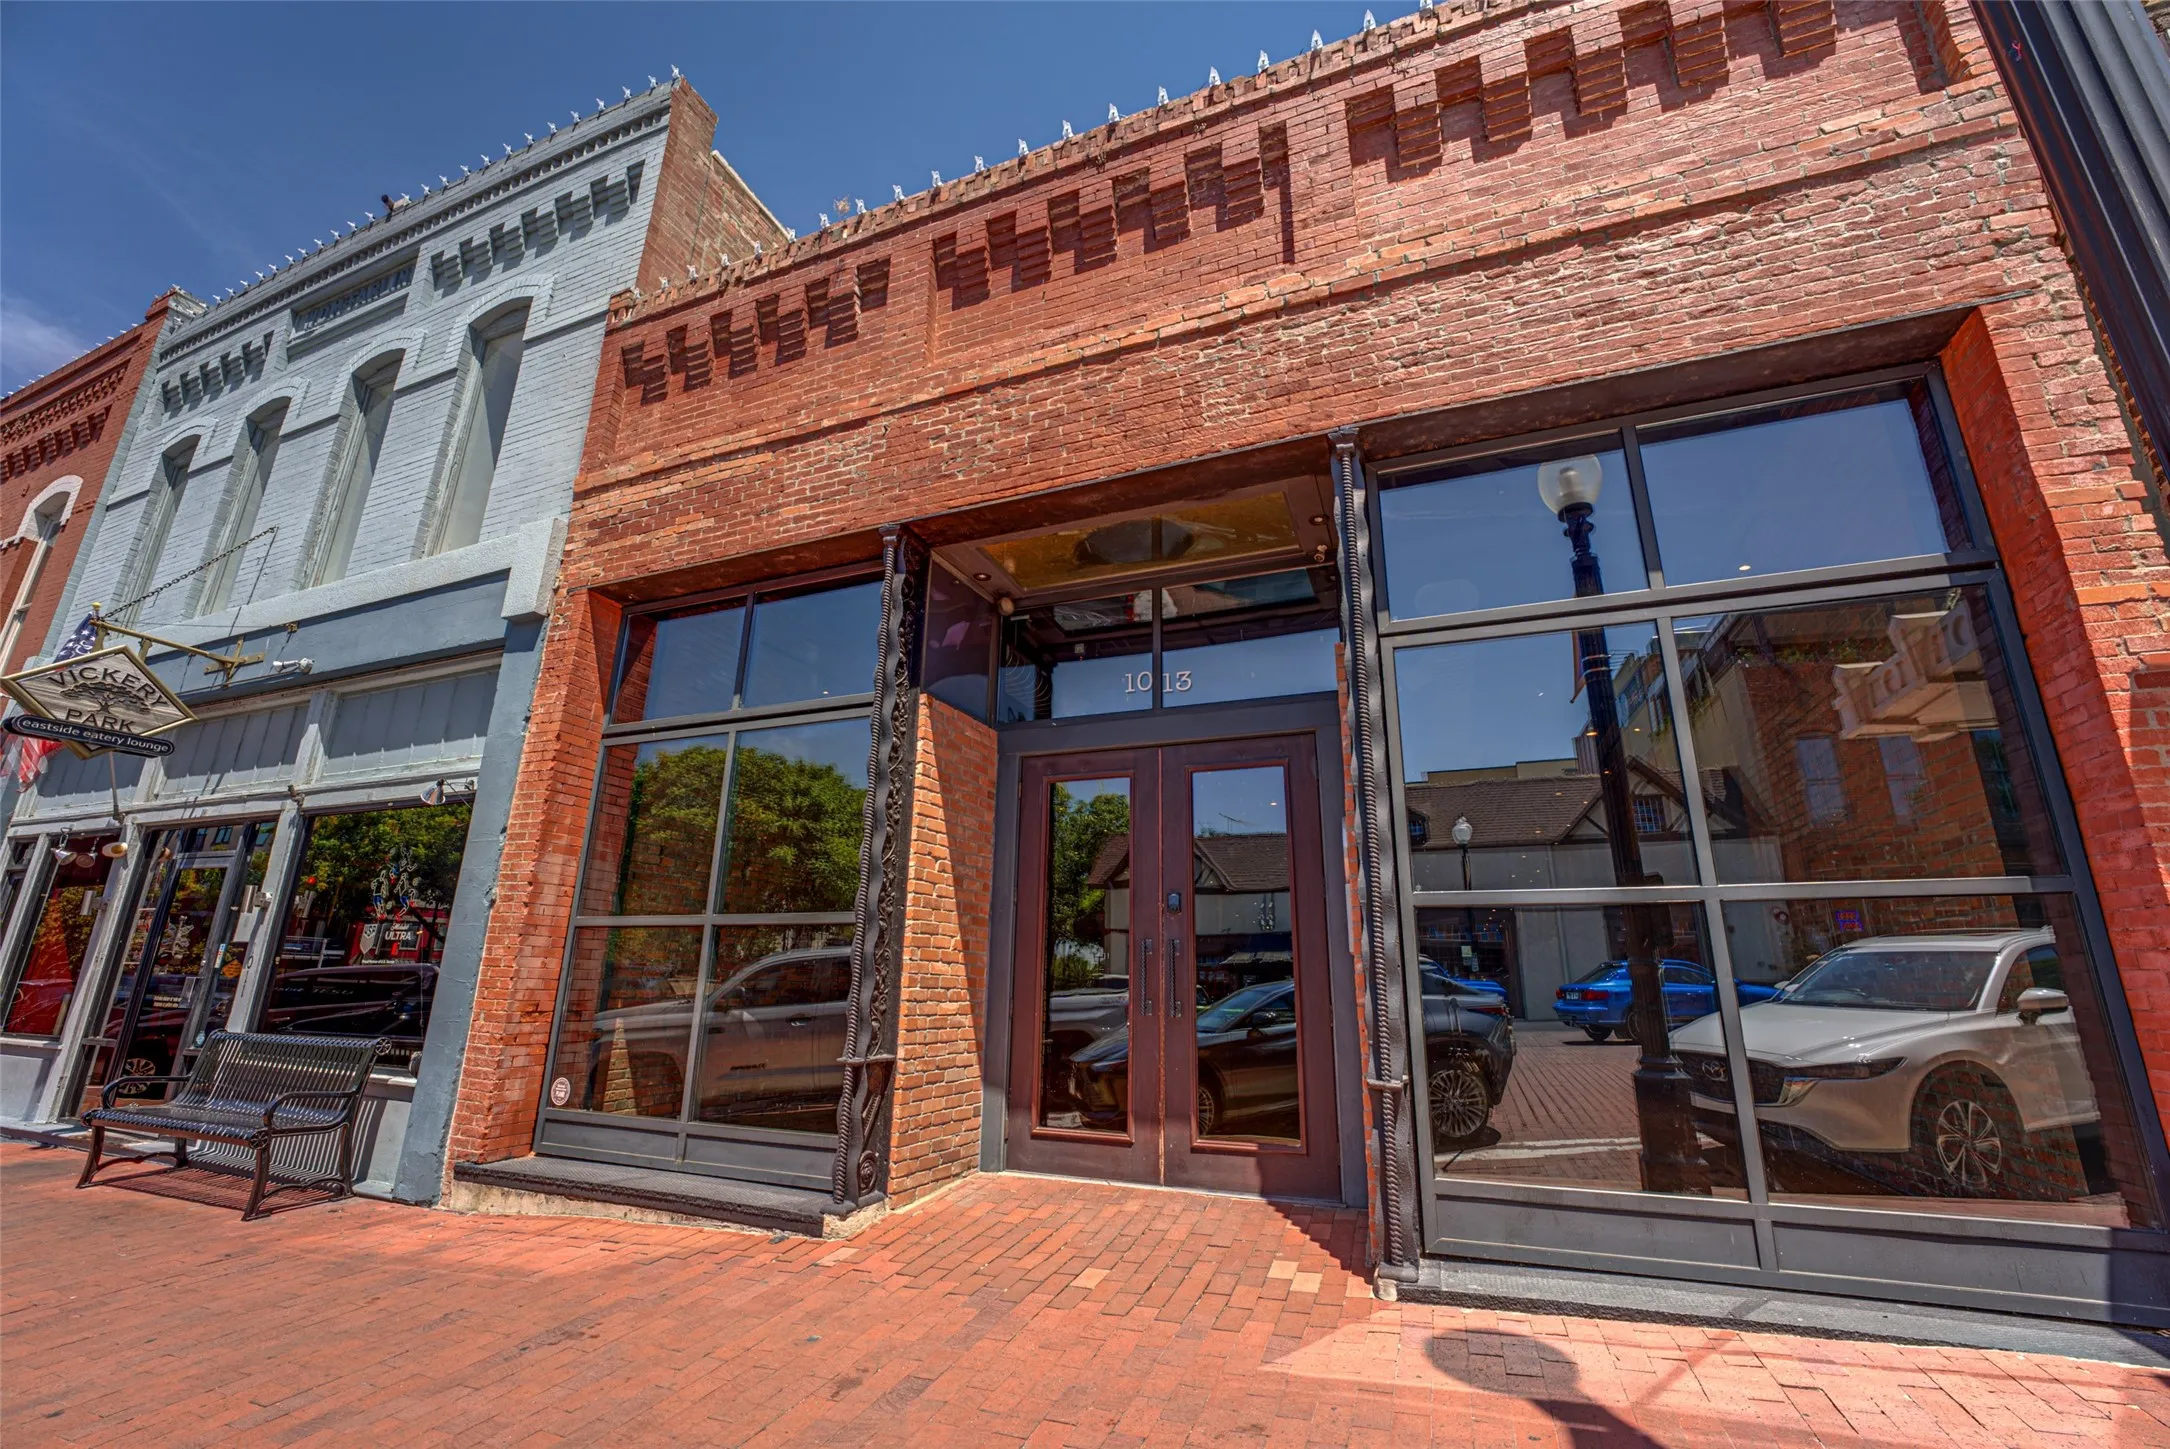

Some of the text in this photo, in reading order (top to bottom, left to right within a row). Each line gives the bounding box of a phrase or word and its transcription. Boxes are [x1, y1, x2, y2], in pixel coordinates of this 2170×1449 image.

[47, 667, 168, 706] VICKERY
[1125, 671, 1192, 692] 1013
[65, 708, 137, 733] PARK
[22, 719, 169, 753] eastside eatery lounge
[385, 931, 411, 940] ULTRA
